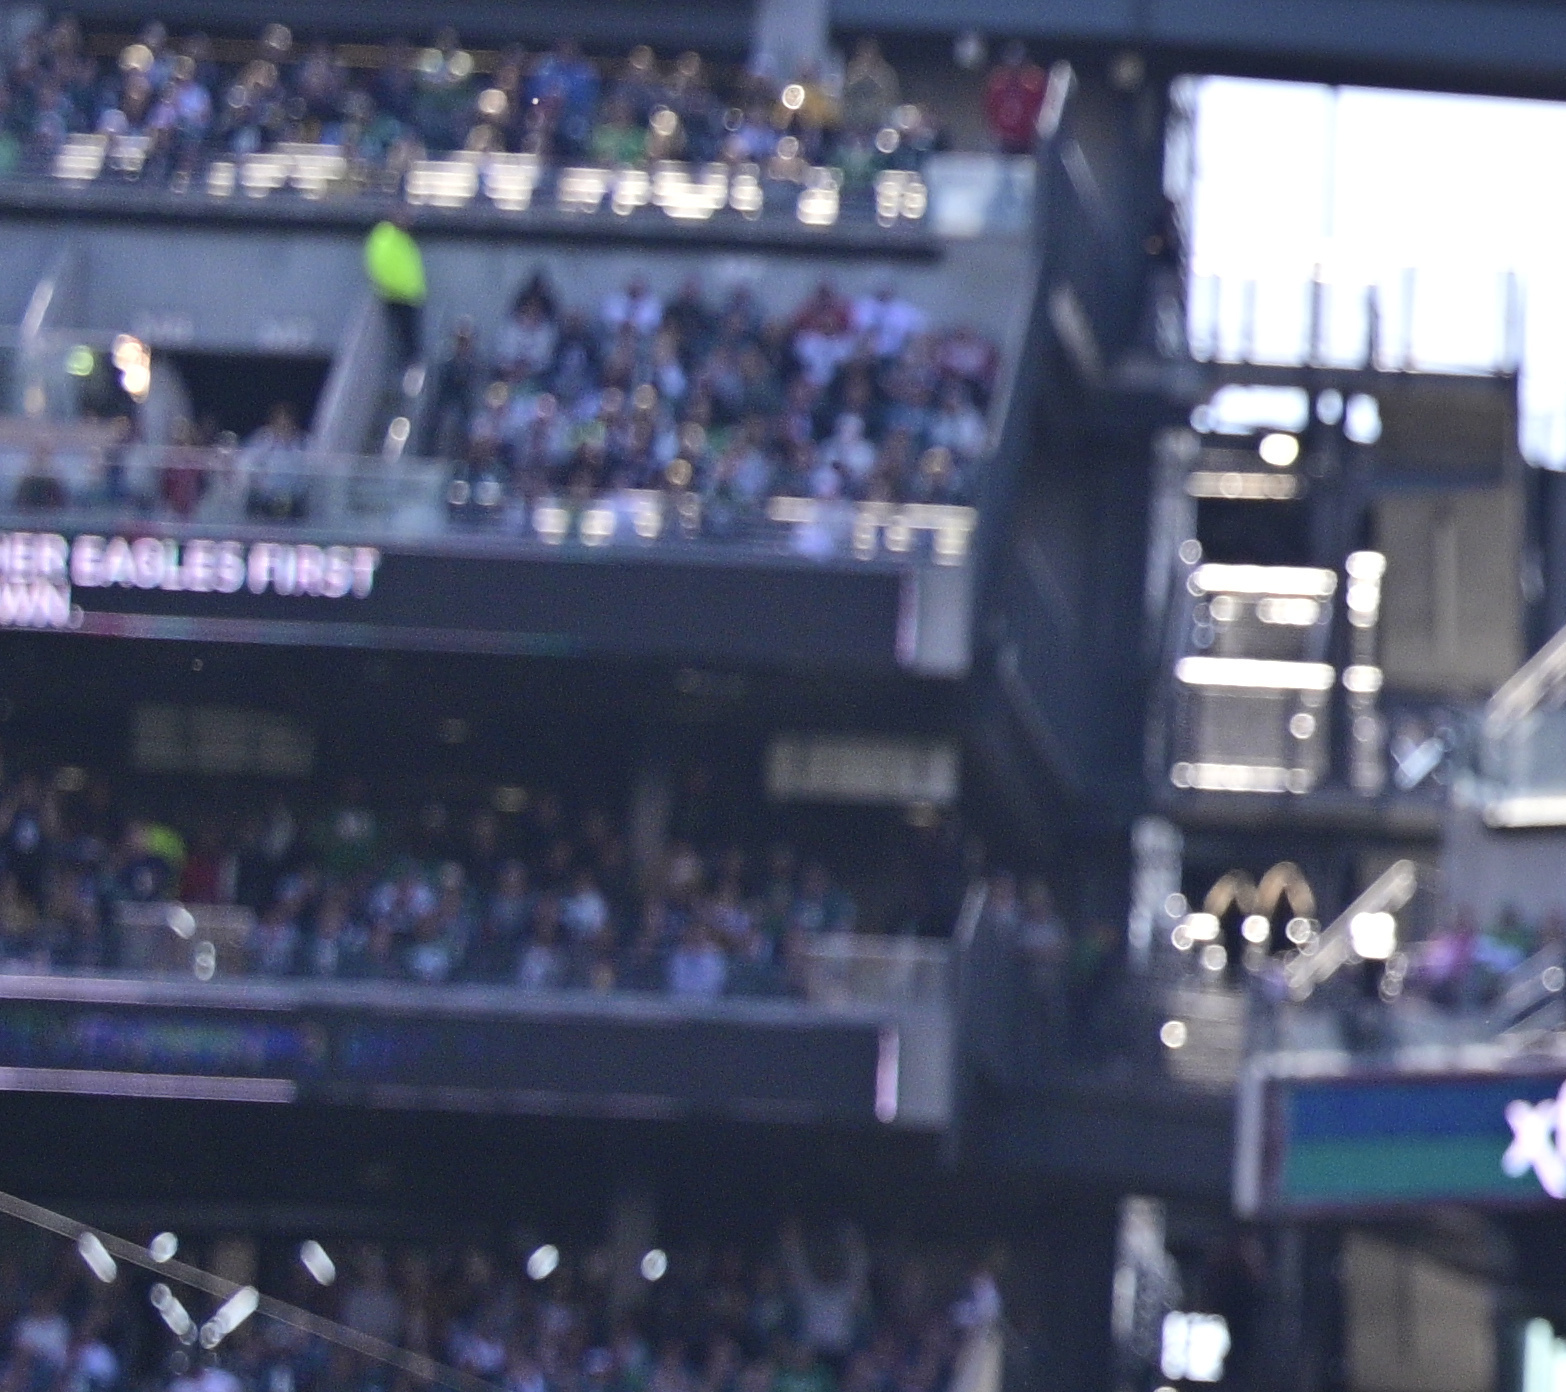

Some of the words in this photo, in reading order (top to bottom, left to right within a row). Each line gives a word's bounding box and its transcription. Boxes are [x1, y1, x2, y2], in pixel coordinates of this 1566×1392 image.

[0, 532, 71, 579] ER
[71, 533, 246, 593] EAGLES
[248, 542, 382, 599] FIRST
